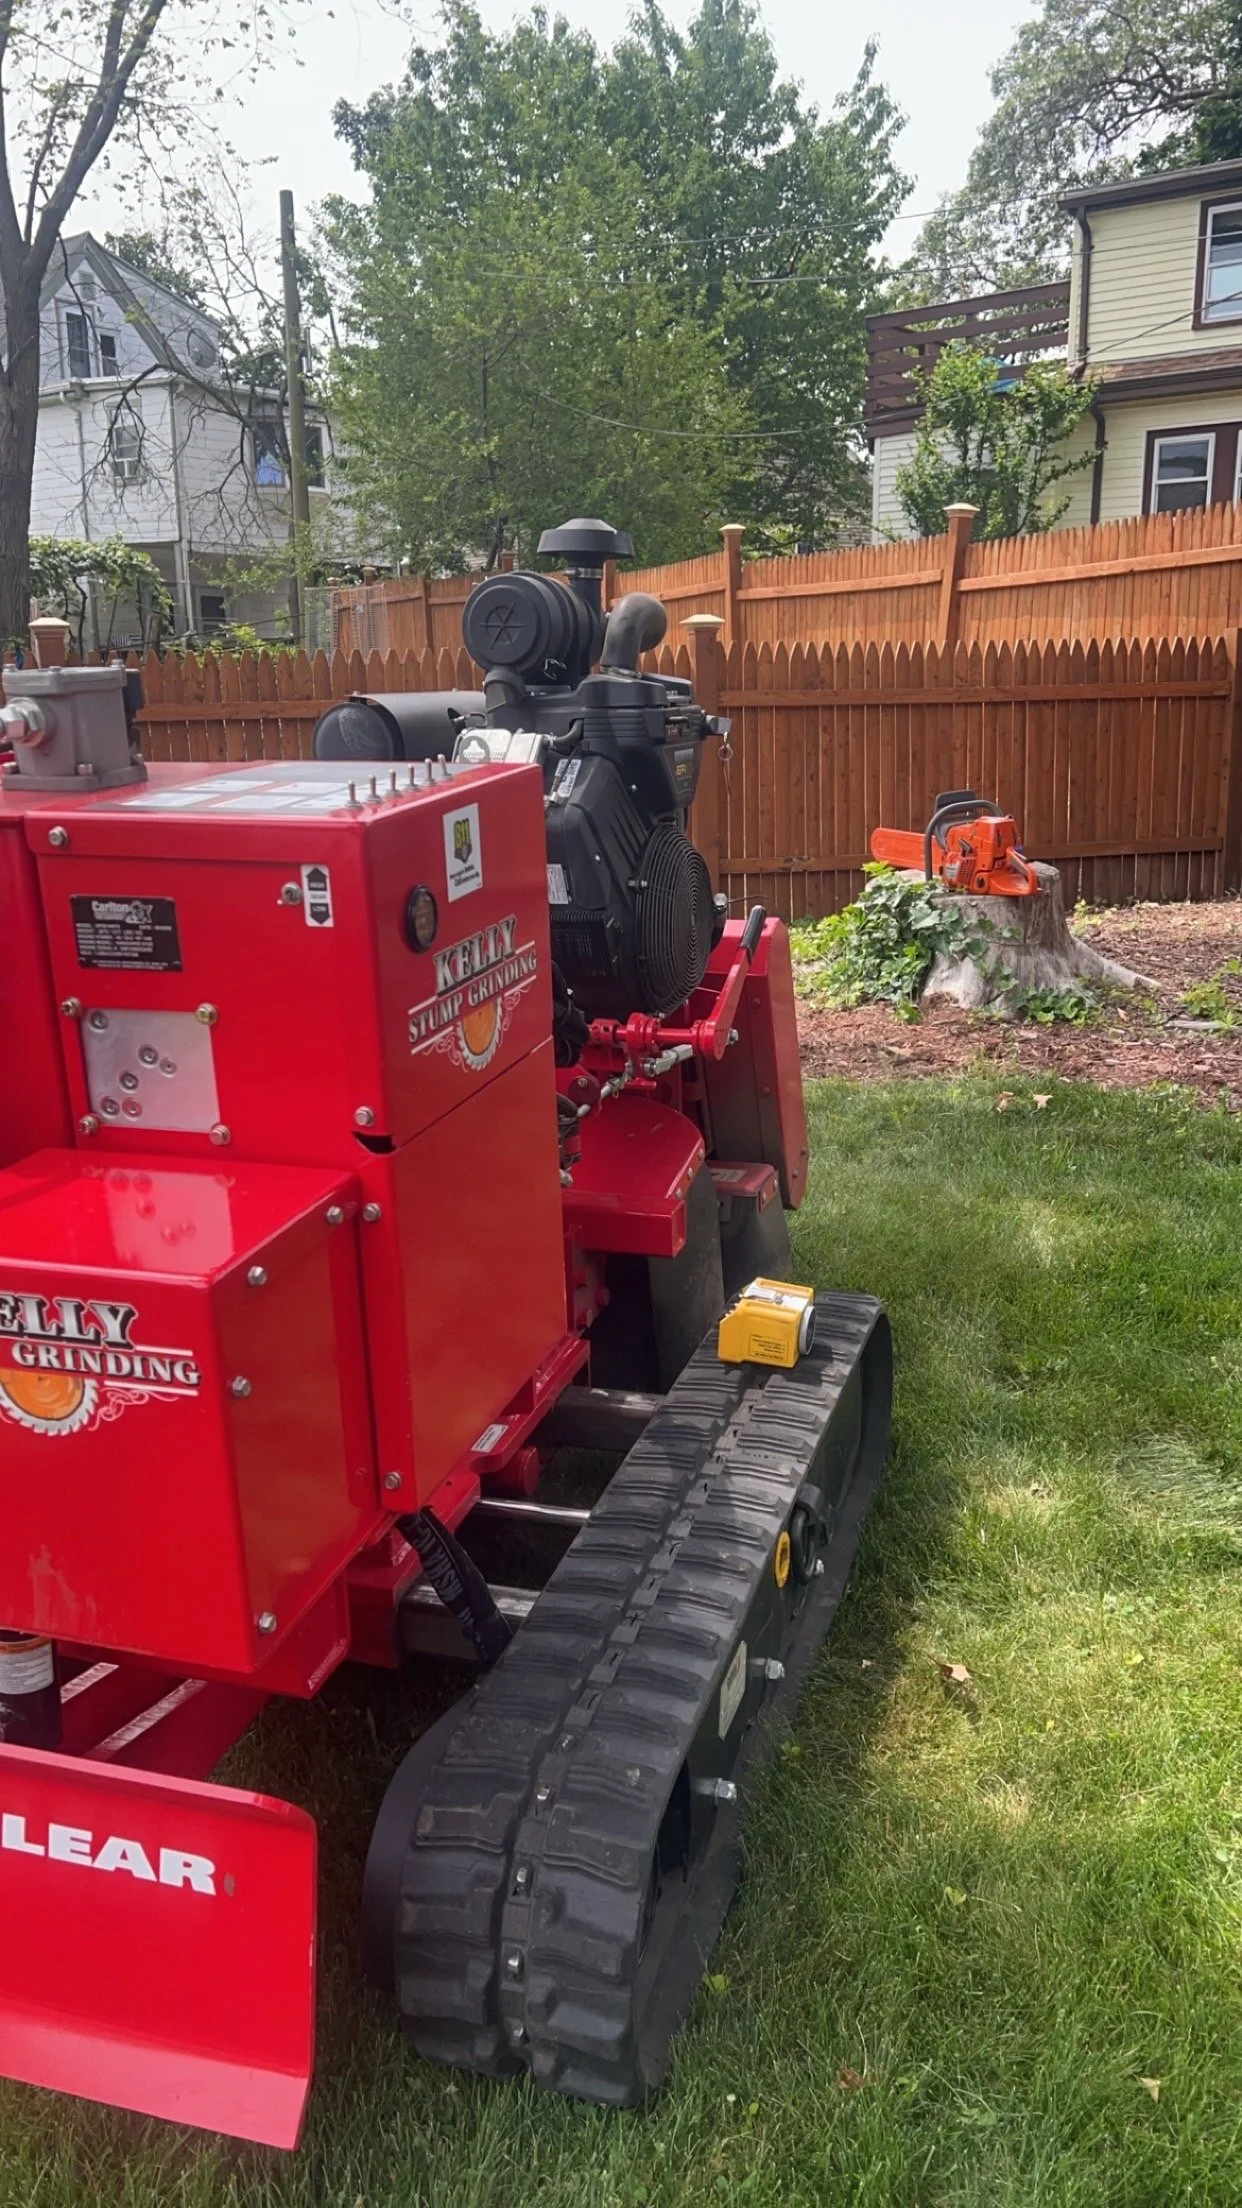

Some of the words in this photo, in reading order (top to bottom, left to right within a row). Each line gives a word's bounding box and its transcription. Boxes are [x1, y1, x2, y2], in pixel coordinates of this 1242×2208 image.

[91, 900, 129, 912] Carlton
[408, 991, 463, 1043] STUMP
[468, 951, 537, 1007] GRINDING
[434, 915, 516, 998] KELLY
[11, 1342, 201, 1386] GRINDING
[2, 1812, 216, 1896] LEAR
